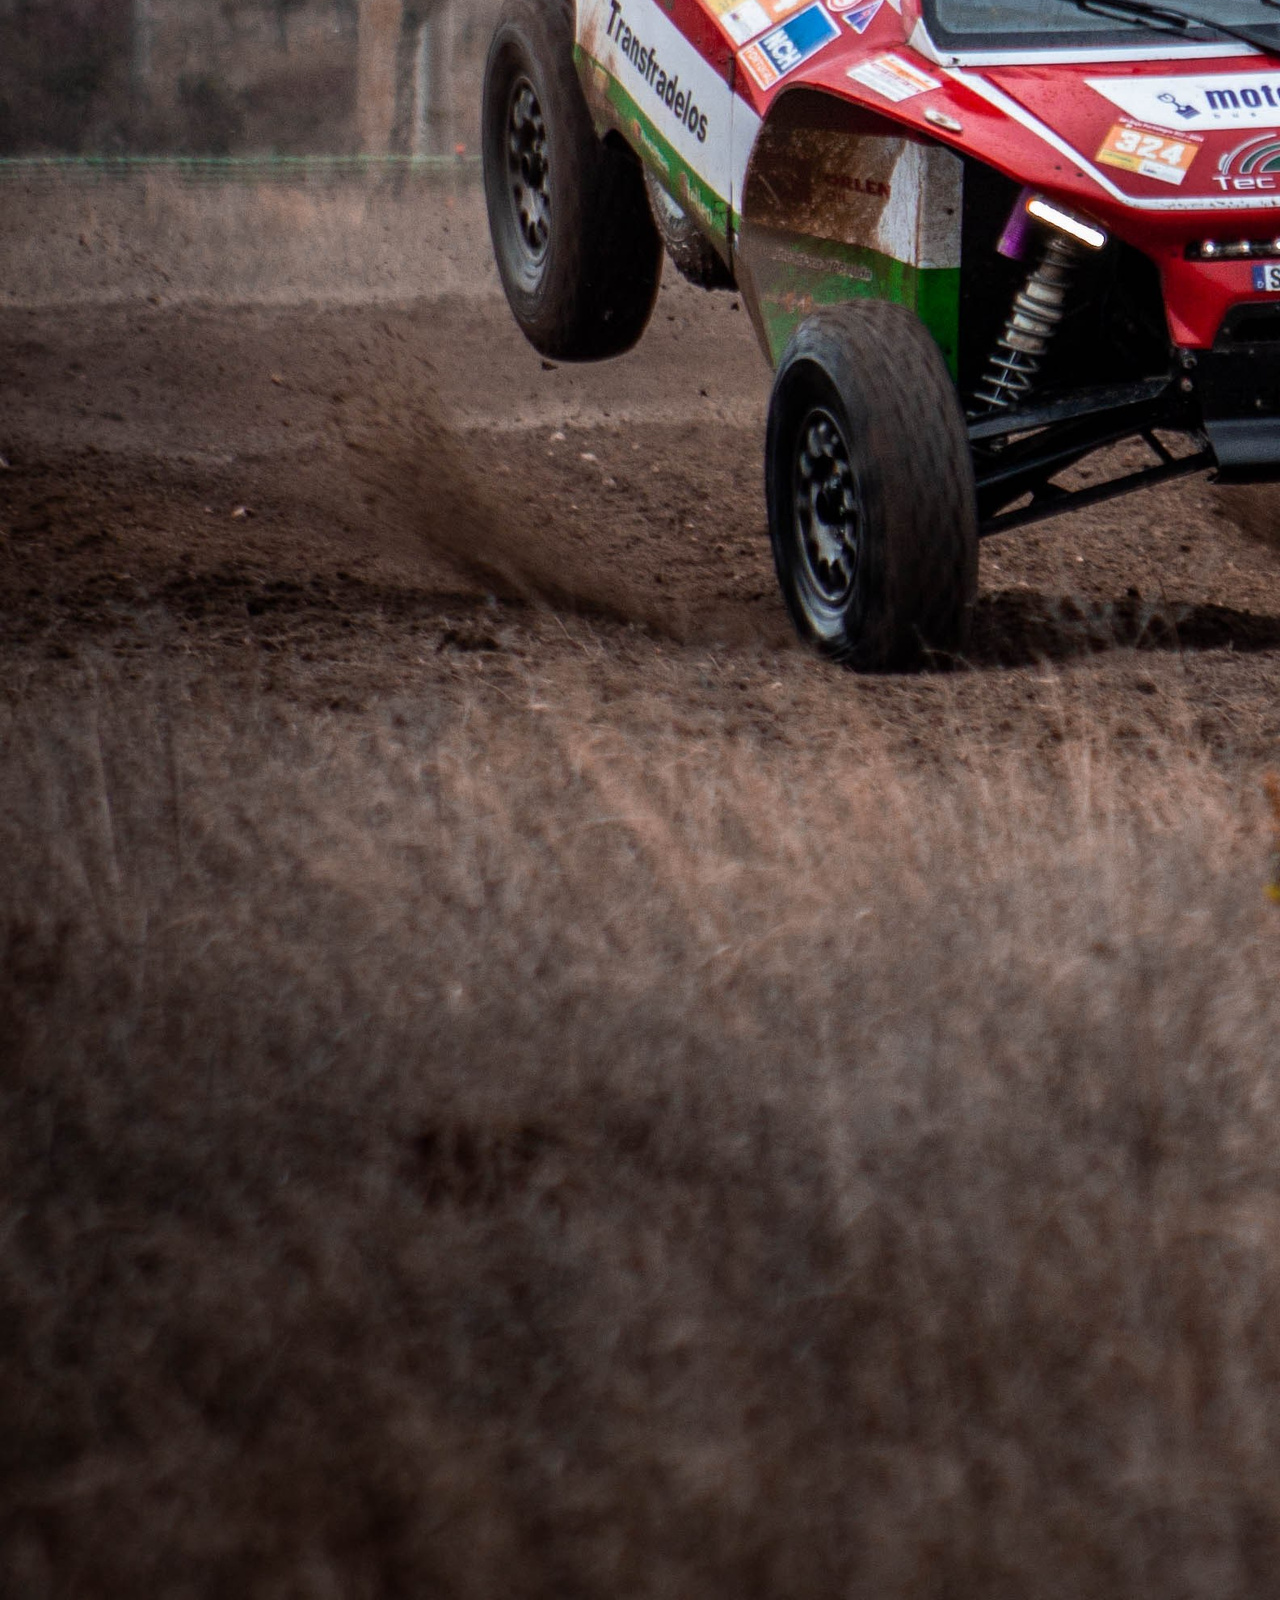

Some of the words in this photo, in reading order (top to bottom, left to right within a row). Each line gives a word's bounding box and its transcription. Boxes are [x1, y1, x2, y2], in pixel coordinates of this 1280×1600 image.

[763, 28, 802, 70] NCH
[1115, 129, 1185, 165] 324
[1212, 175, 1276, 191] Tec
[1256, 279, 1265, 289] D
